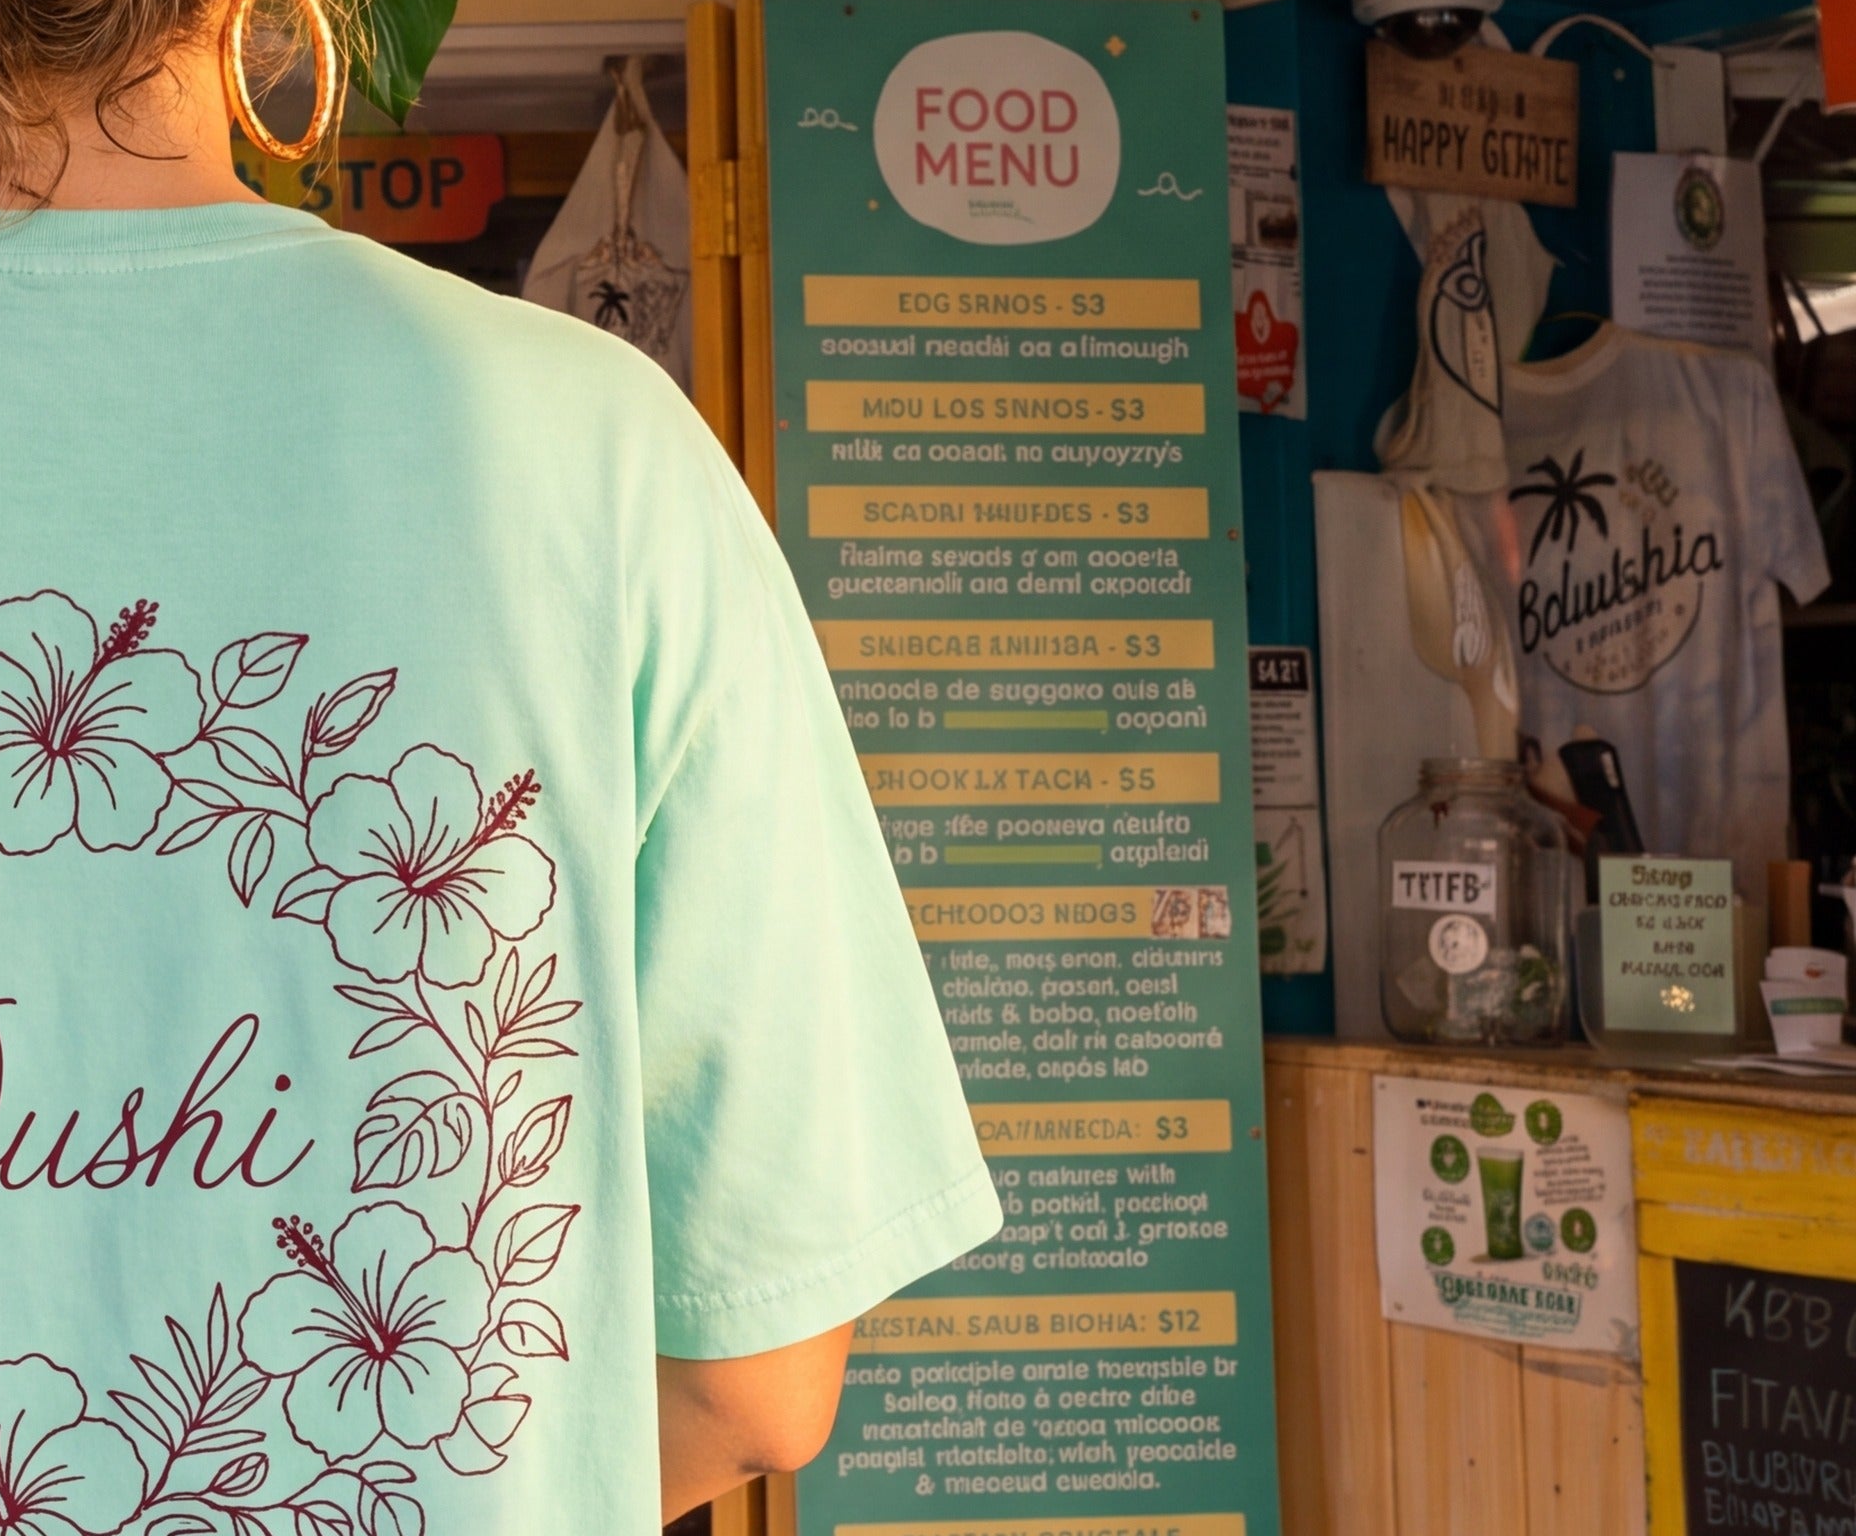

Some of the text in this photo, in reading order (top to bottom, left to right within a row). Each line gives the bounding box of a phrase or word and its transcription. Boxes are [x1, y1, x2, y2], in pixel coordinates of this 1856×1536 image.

[915, 87, 1078, 134] FOOD
[1383, 114, 1470, 172] HAPPY
[915, 142, 1080, 188] MENU
[299, 156, 465, 213] STOP
[933, 397, 985, 420] LOS
[1119, 768, 1155, 792] $5
[1156, 1116, 1189, 1140] $3
[1158, 1309, 1201, 1333] $12
